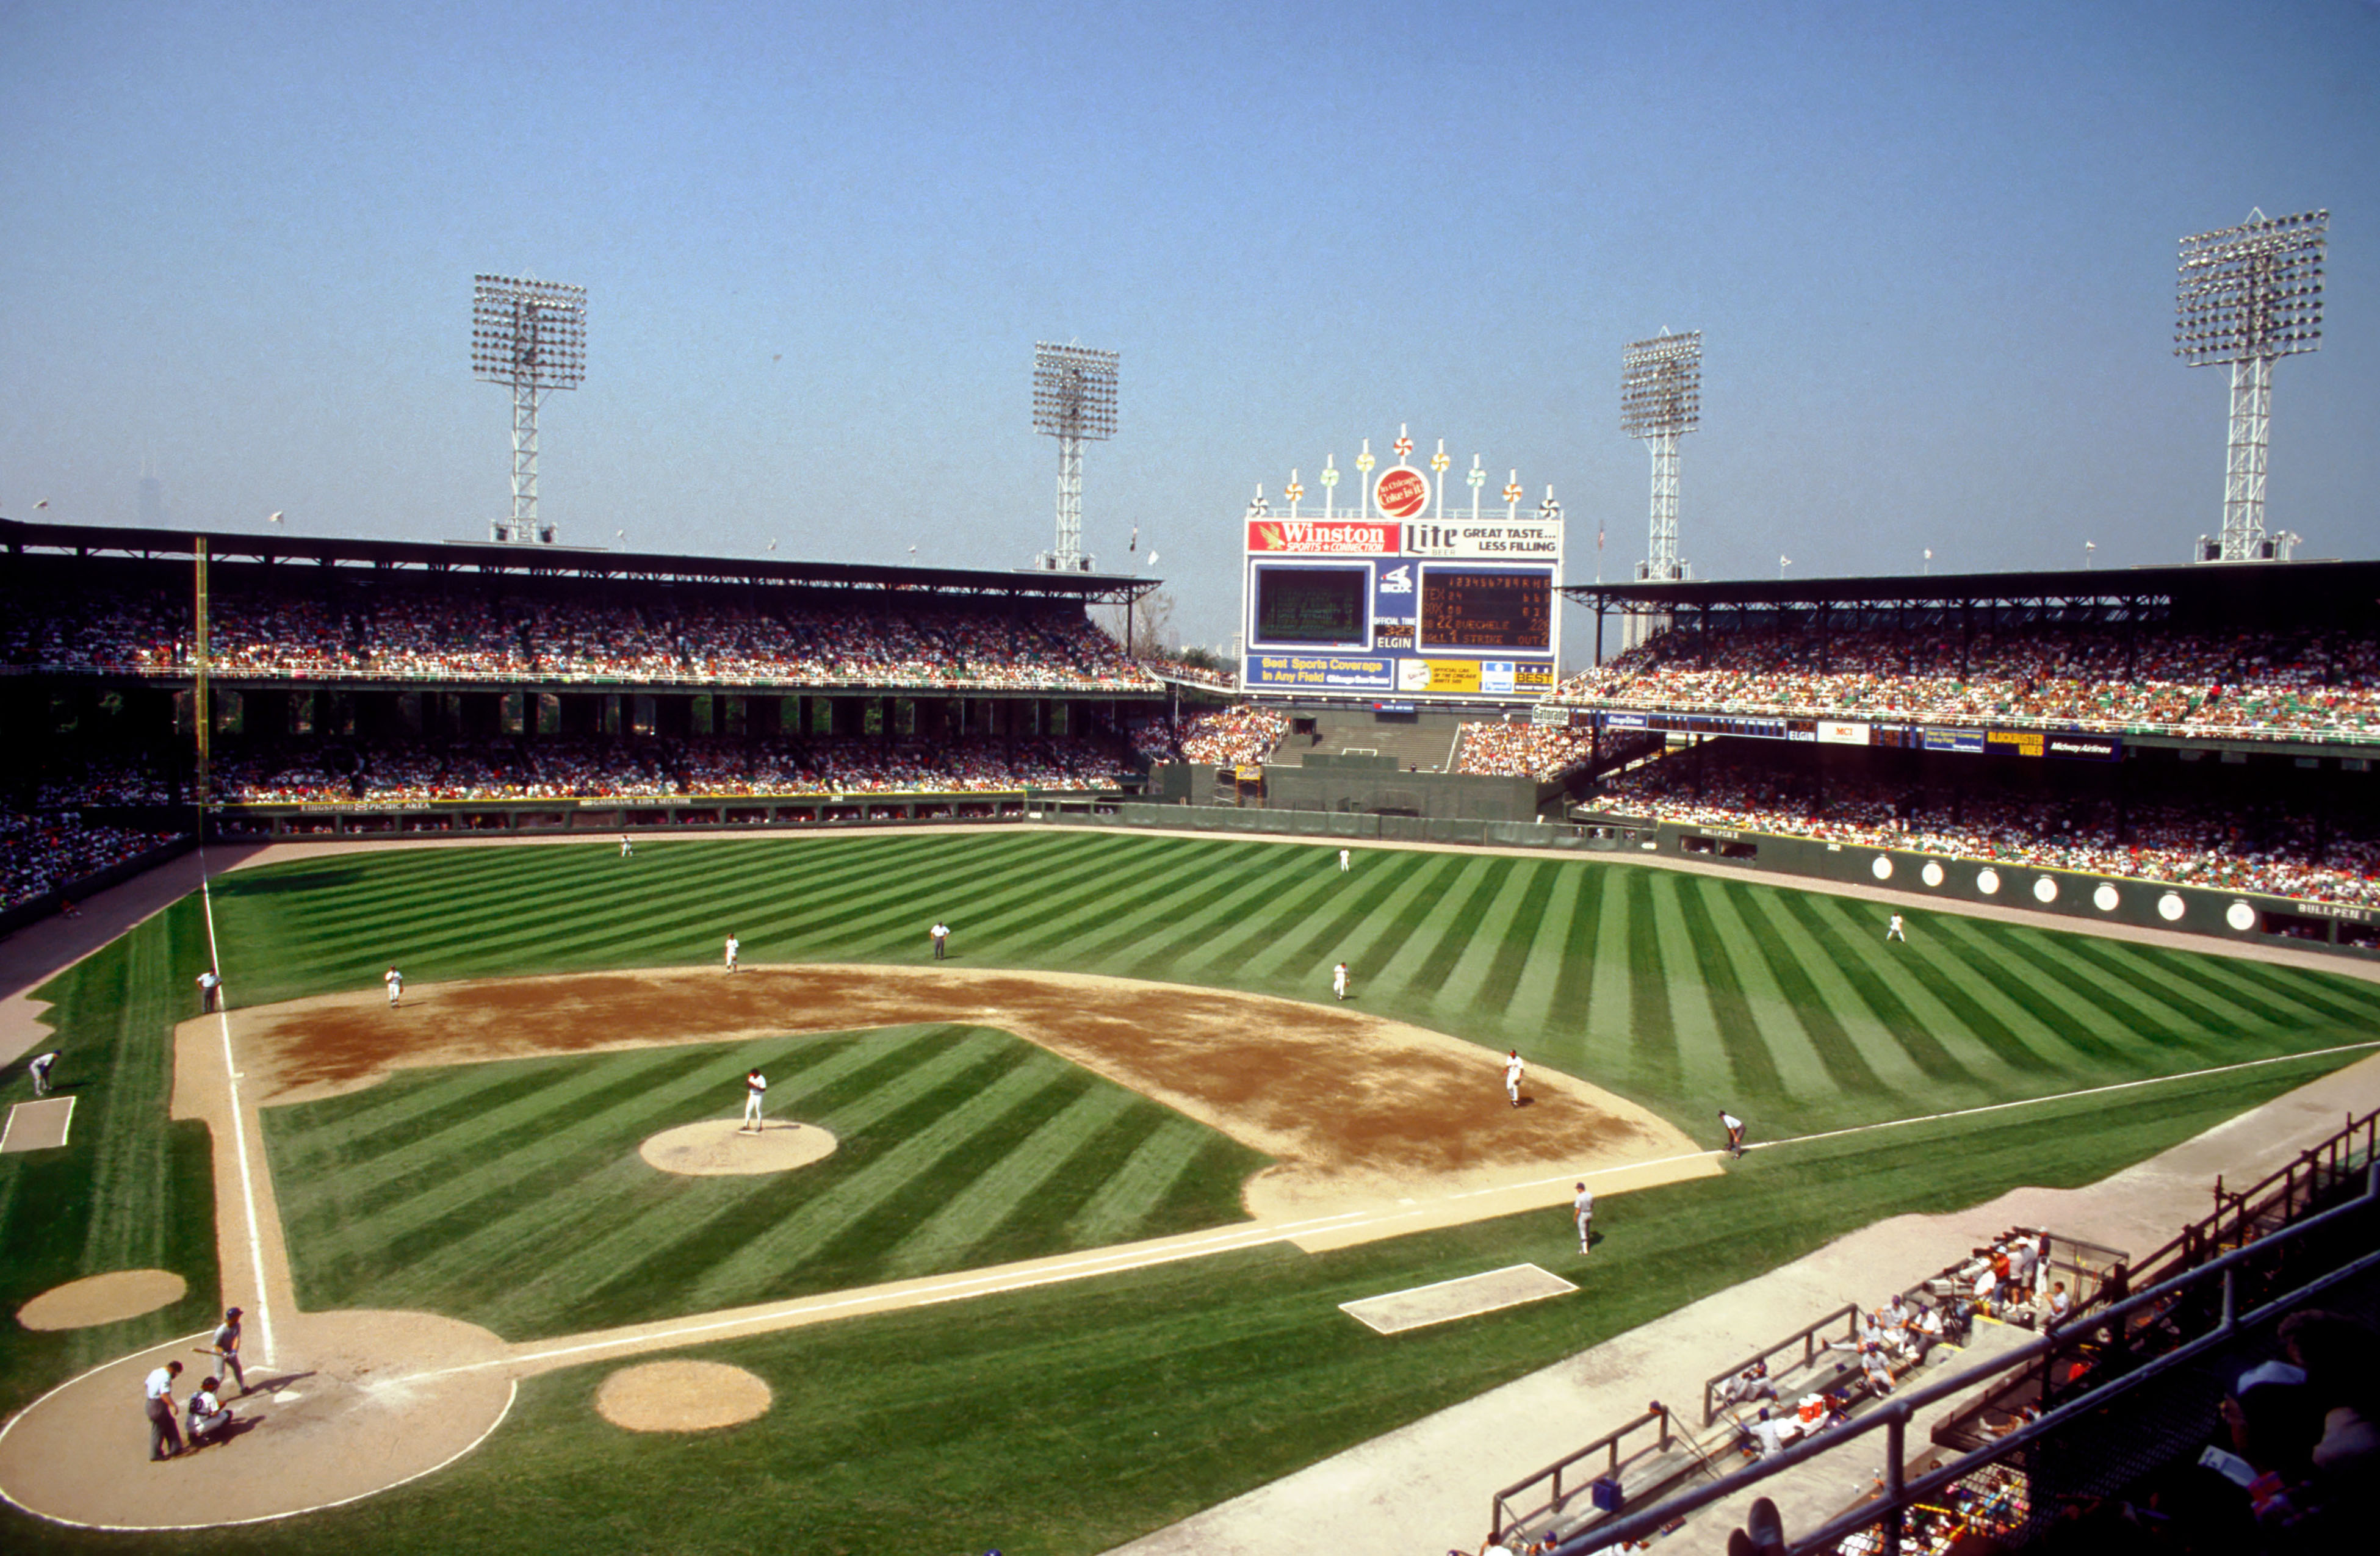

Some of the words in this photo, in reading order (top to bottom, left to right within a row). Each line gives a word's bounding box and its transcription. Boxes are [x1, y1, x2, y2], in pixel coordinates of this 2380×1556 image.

[1379, 492, 1404, 506] Coke
[1403, 487, 1414, 499] is
[1282, 522, 1385, 542] Winston
[1463, 528, 1503, 538] GREAT
[1507, 528, 1556, 539] TASTE...
[1405, 524, 1458, 554] Lite
[1286, 542, 1322, 552] SPORTS
[1330, 542, 1385, 552] CONNECTION
[1479, 541, 1506, 551] LESS
[1509, 542, 1556, 552] FILLING
[1380, 583, 1412, 593] SOX
[1424, 588, 1445, 600] TEX
[1374, 617, 1399, 625] OFFICIAL
[1401, 617, 1416, 625] TIME
[1437, 615, 1453, 629] 22
[1377, 637, 1412, 648] ELGIN
[1463, 634, 1504, 644] STRIKE
[1518, 635, 1540, 645] OUT
[1541, 632, 1549, 646] 2
[1262, 658, 1287, 668] Best
[1291, 658, 1327, 670] Sports
[1330, 659, 1382, 672] Coverage
[1262, 671, 1272, 680] In
[1274, 671, 1296, 683] Any
[1297, 672, 1324, 682] Field
[1516, 673, 1552, 683] BEST
[1533, 707, 1568, 721] Gatorade
[1789, 731, 1815, 741] ELGIN
[1836, 726, 1853, 736] MCI
[1987, 732, 2044, 745] BLOCKBUSTER
[2019, 744, 2044, 757] VIDEO
[2050, 741, 2081, 753] Midway
[2080, 744, 2111, 754] Airlines
[301, 803, 354, 812] KINGSFORD
[2298, 903, 2360, 920] BULLPEN
